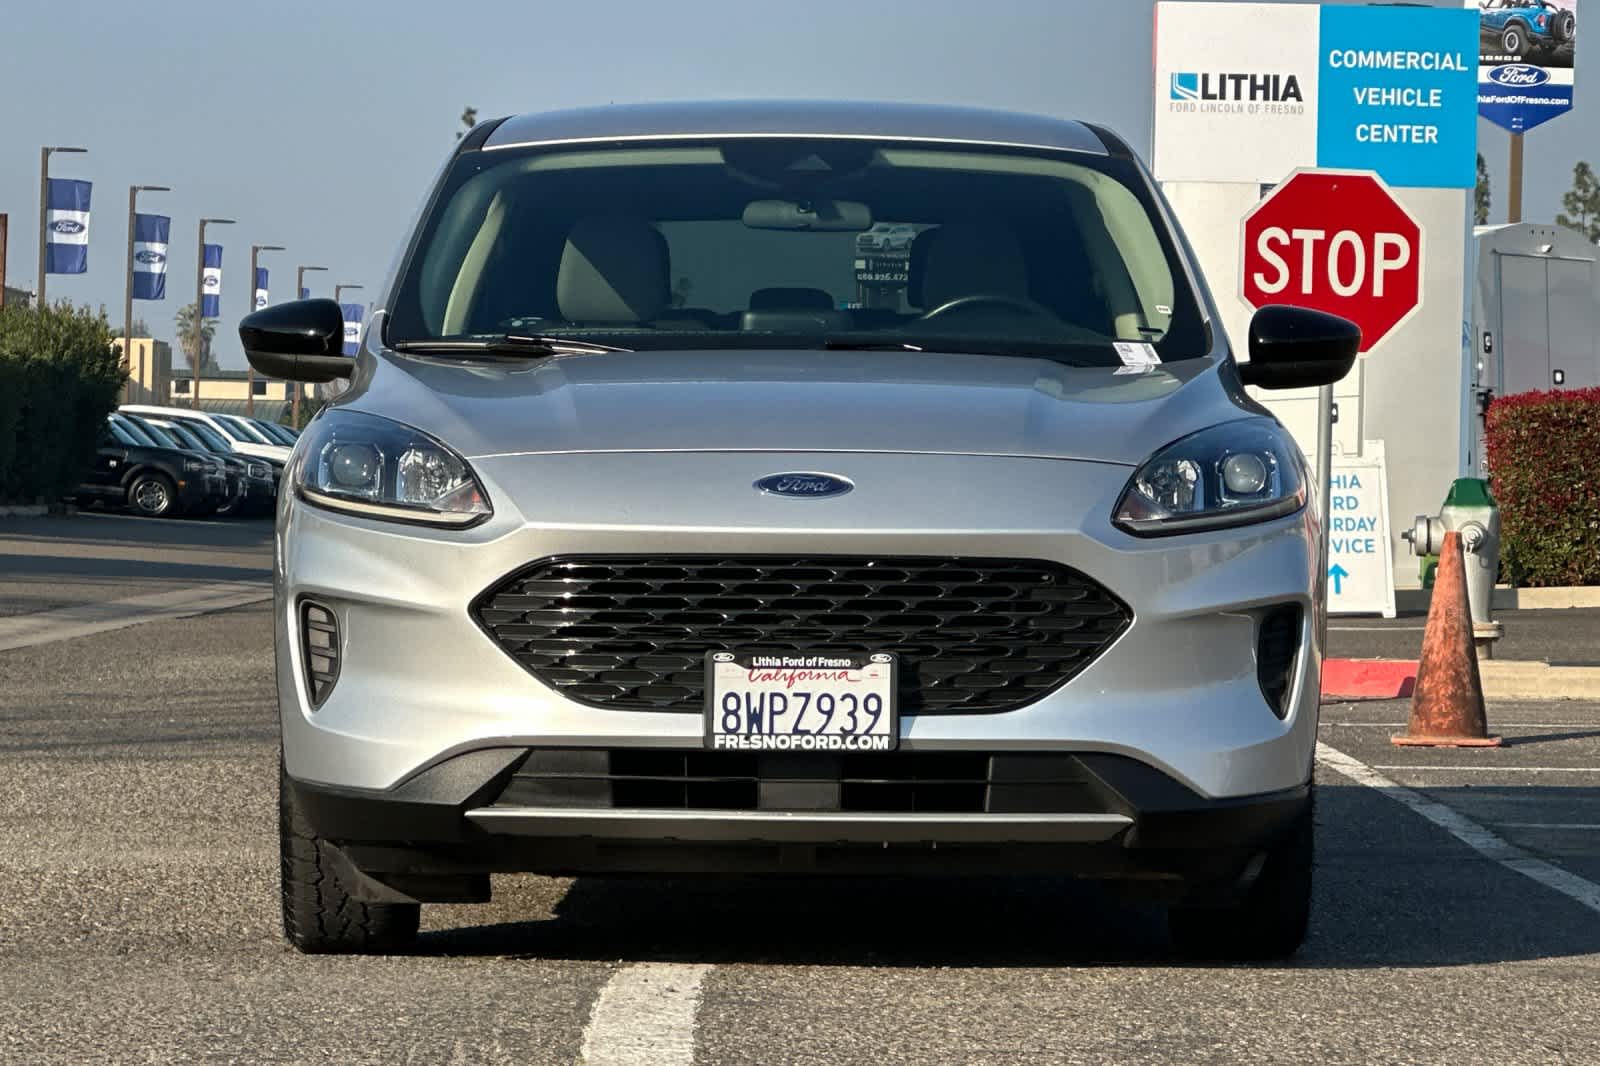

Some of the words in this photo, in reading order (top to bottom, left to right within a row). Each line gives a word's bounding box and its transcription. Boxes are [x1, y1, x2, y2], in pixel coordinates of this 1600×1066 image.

[1329, 49, 1469, 71] COMMERCIAL
[1499, 66, 1538, 83] Ford
[1201, 73, 1303, 102] LITHIA
[1353, 87, 1442, 107] VEHICLE
[1170, 102, 1196, 112] FORD
[1200, 103, 1243, 113] LINCOLN
[1248, 103, 1260, 113] OF
[1265, 104, 1304, 115] FRESNO
[1356, 123, 1438, 144] CENTER
[55, 221, 79, 233] Ford
[1253, 226, 1410, 297] STOP
[776, 475, 831, 492] Ford
[752, 656, 780, 667] Lithia
[782, 656, 804, 667] Ford
[805, 656, 817, 667] of
[818, 657, 851, 667] Fresno
[748, 668, 860, 688] California
[721, 691, 883, 735] 8WPZ939
[714, 735, 890, 750] FRESNOFORD.COM
